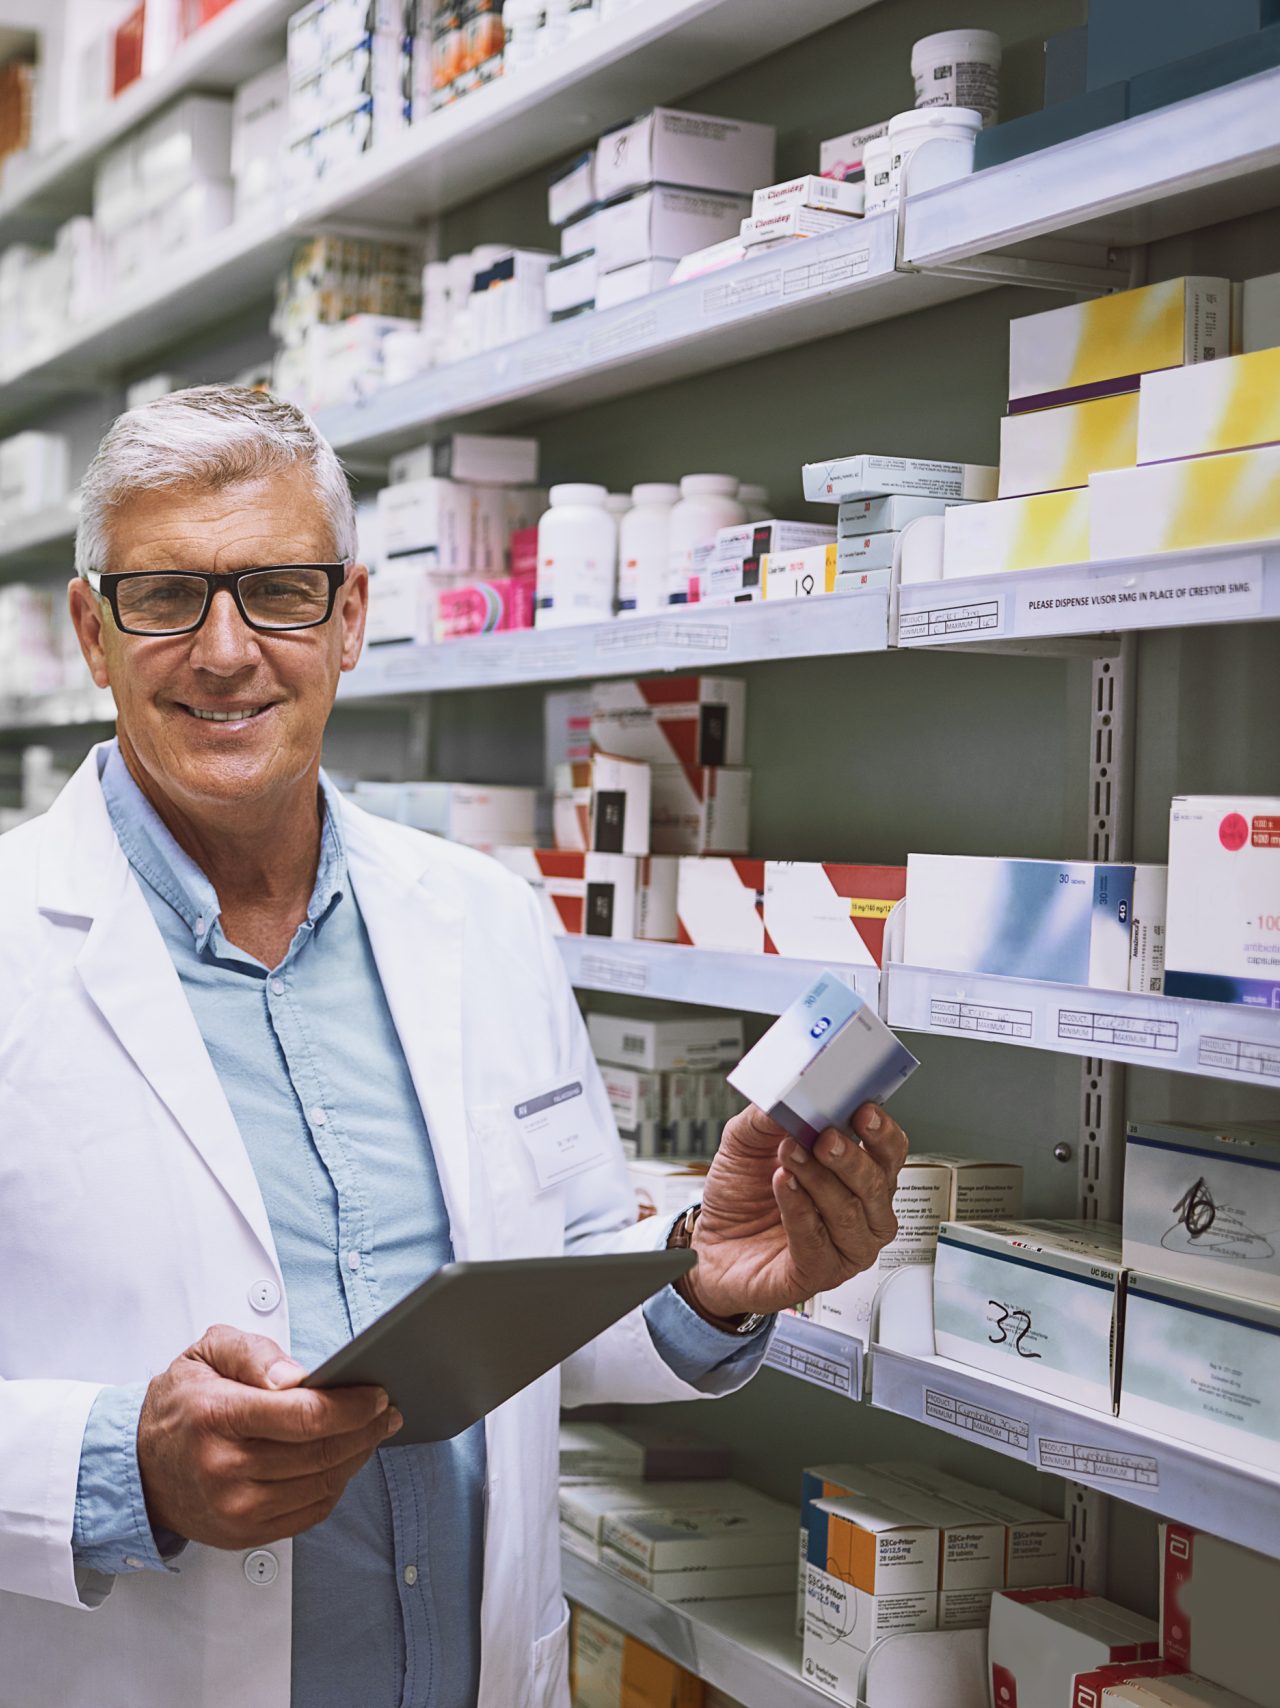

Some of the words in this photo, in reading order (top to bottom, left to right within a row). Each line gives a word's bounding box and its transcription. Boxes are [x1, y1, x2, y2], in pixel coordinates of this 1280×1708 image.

[767, 183, 804, 200] Clomidep
[755, 213, 791, 229] Clomidep
[1028, 600, 1054, 610] PLEASE
[1055, 597, 1089, 609] DISPENSE
[1118, 593, 1137, 603] 5MG
[1139, 592, 1148, 602] IN
[1149, 589, 1174, 600] PLACE
[1176, 588, 1187, 598] OF
[1188, 584, 1226, 597] CRESTOR
[1059, 873, 1069, 884] 30
[1119, 904, 1127, 920] 40
[1060, 1027, 1089, 1036] MINIMUM
[1091, 1267, 1100, 1276] UC
[1100, 1270, 1114, 1280] 9543
[927, 1404, 953, 1420] MINIMUM
[973, 1421, 1002, 1437] MAXIMUM
[1040, 1455, 1071, 1466] MINIMUM
[1095, 1464, 1128, 1476] MAXIMUM
